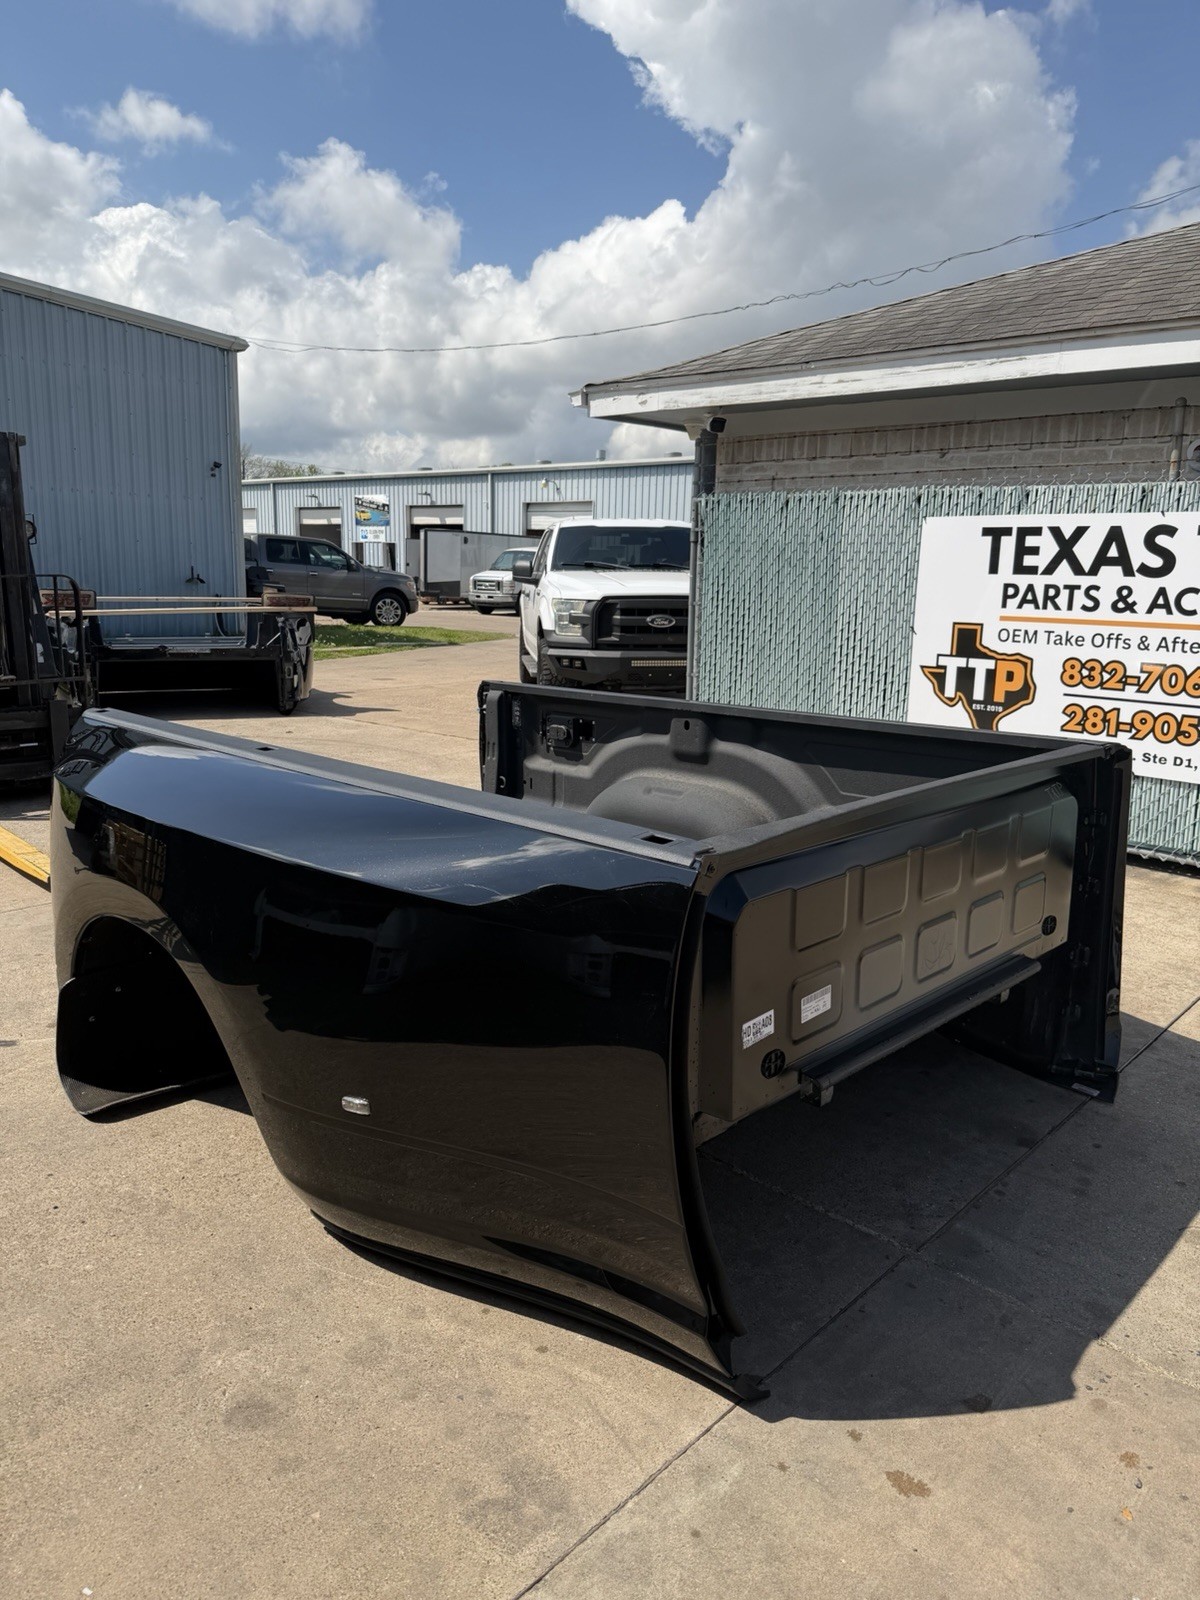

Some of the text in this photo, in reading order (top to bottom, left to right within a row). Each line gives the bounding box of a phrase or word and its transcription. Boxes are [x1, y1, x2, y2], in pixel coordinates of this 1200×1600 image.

[981, 523, 1179, 579] TEXAS
[1001, 582, 1200, 617] PARTS & AC
[997, 628, 1200, 655] OEM Take Offs & Afte
[937, 654, 1025, 703] TTP
[1060, 657, 1200, 699] 832-706
[972, 703, 1003, 712] EST. 2019
[1060, 702, 1200, 747] 281-905
[1141, 752, 1199, 772] Ste D1,
